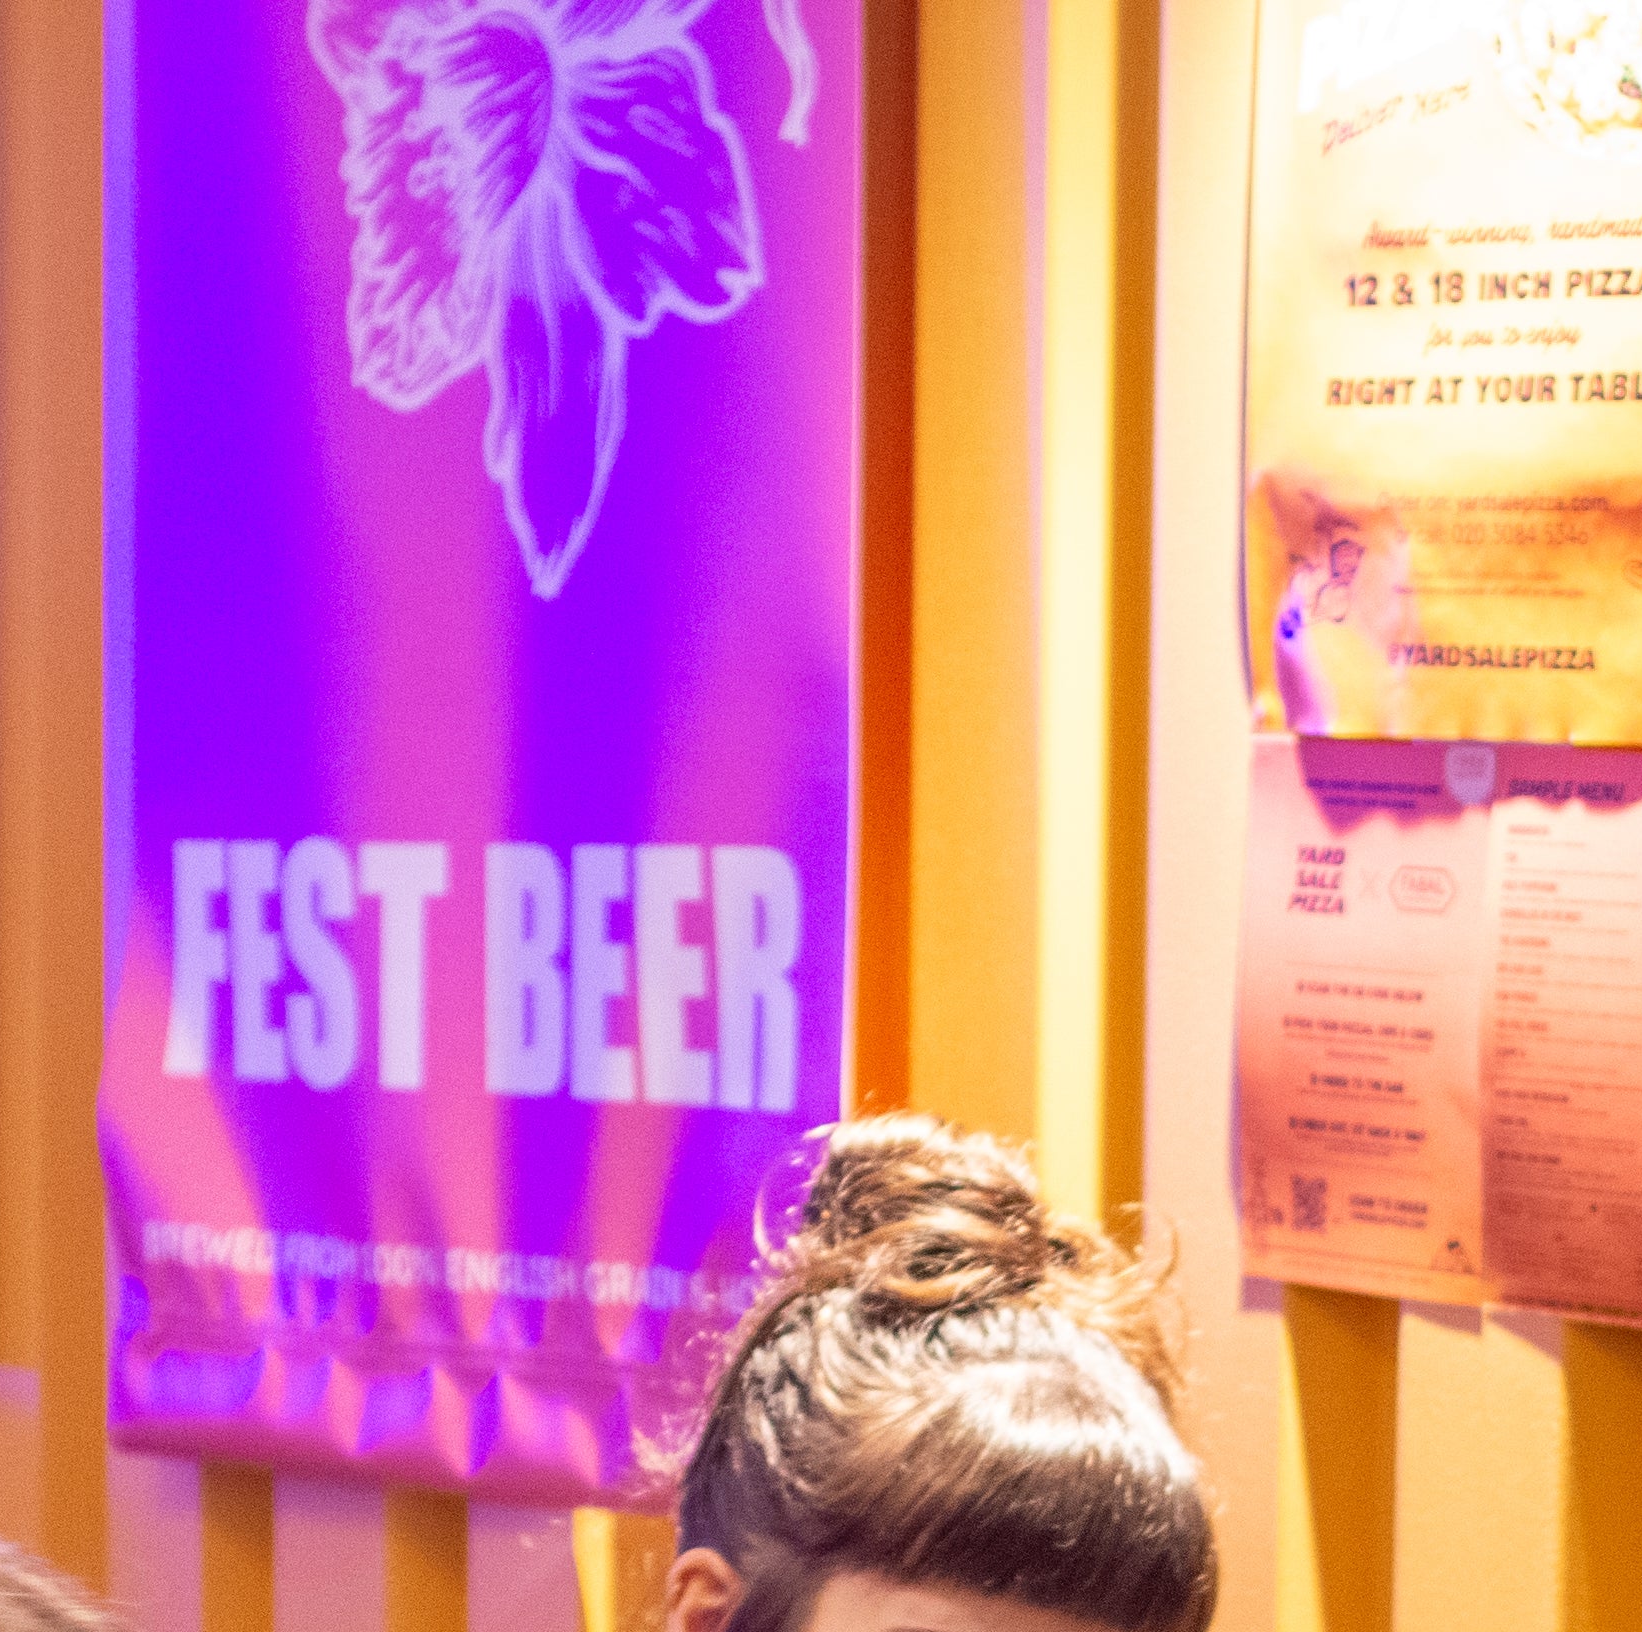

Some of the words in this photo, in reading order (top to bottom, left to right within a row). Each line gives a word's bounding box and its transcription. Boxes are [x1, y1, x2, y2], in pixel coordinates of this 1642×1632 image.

[1345, 272, 1378, 307] 12
[1392, 271, 1414, 306] &
[1430, 270, 1464, 305] 18
[1478, 270, 1553, 301] INCH
[1326, 376, 1415, 406] RIGHT
[1425, 374, 1463, 405] AT
[1476, 373, 1557, 403] YOUR
[1296, 846, 1345, 866] YARD
[1296, 870, 1341, 889] SALE
[1287, 893, 1344, 914] PIZZA
[163, 836, 448, 1090] FEST
[485, 842, 803, 1112] BEER
[142, 1218, 274, 1275] BREWED
[445, 1248, 577, 1302] ENGLISH
